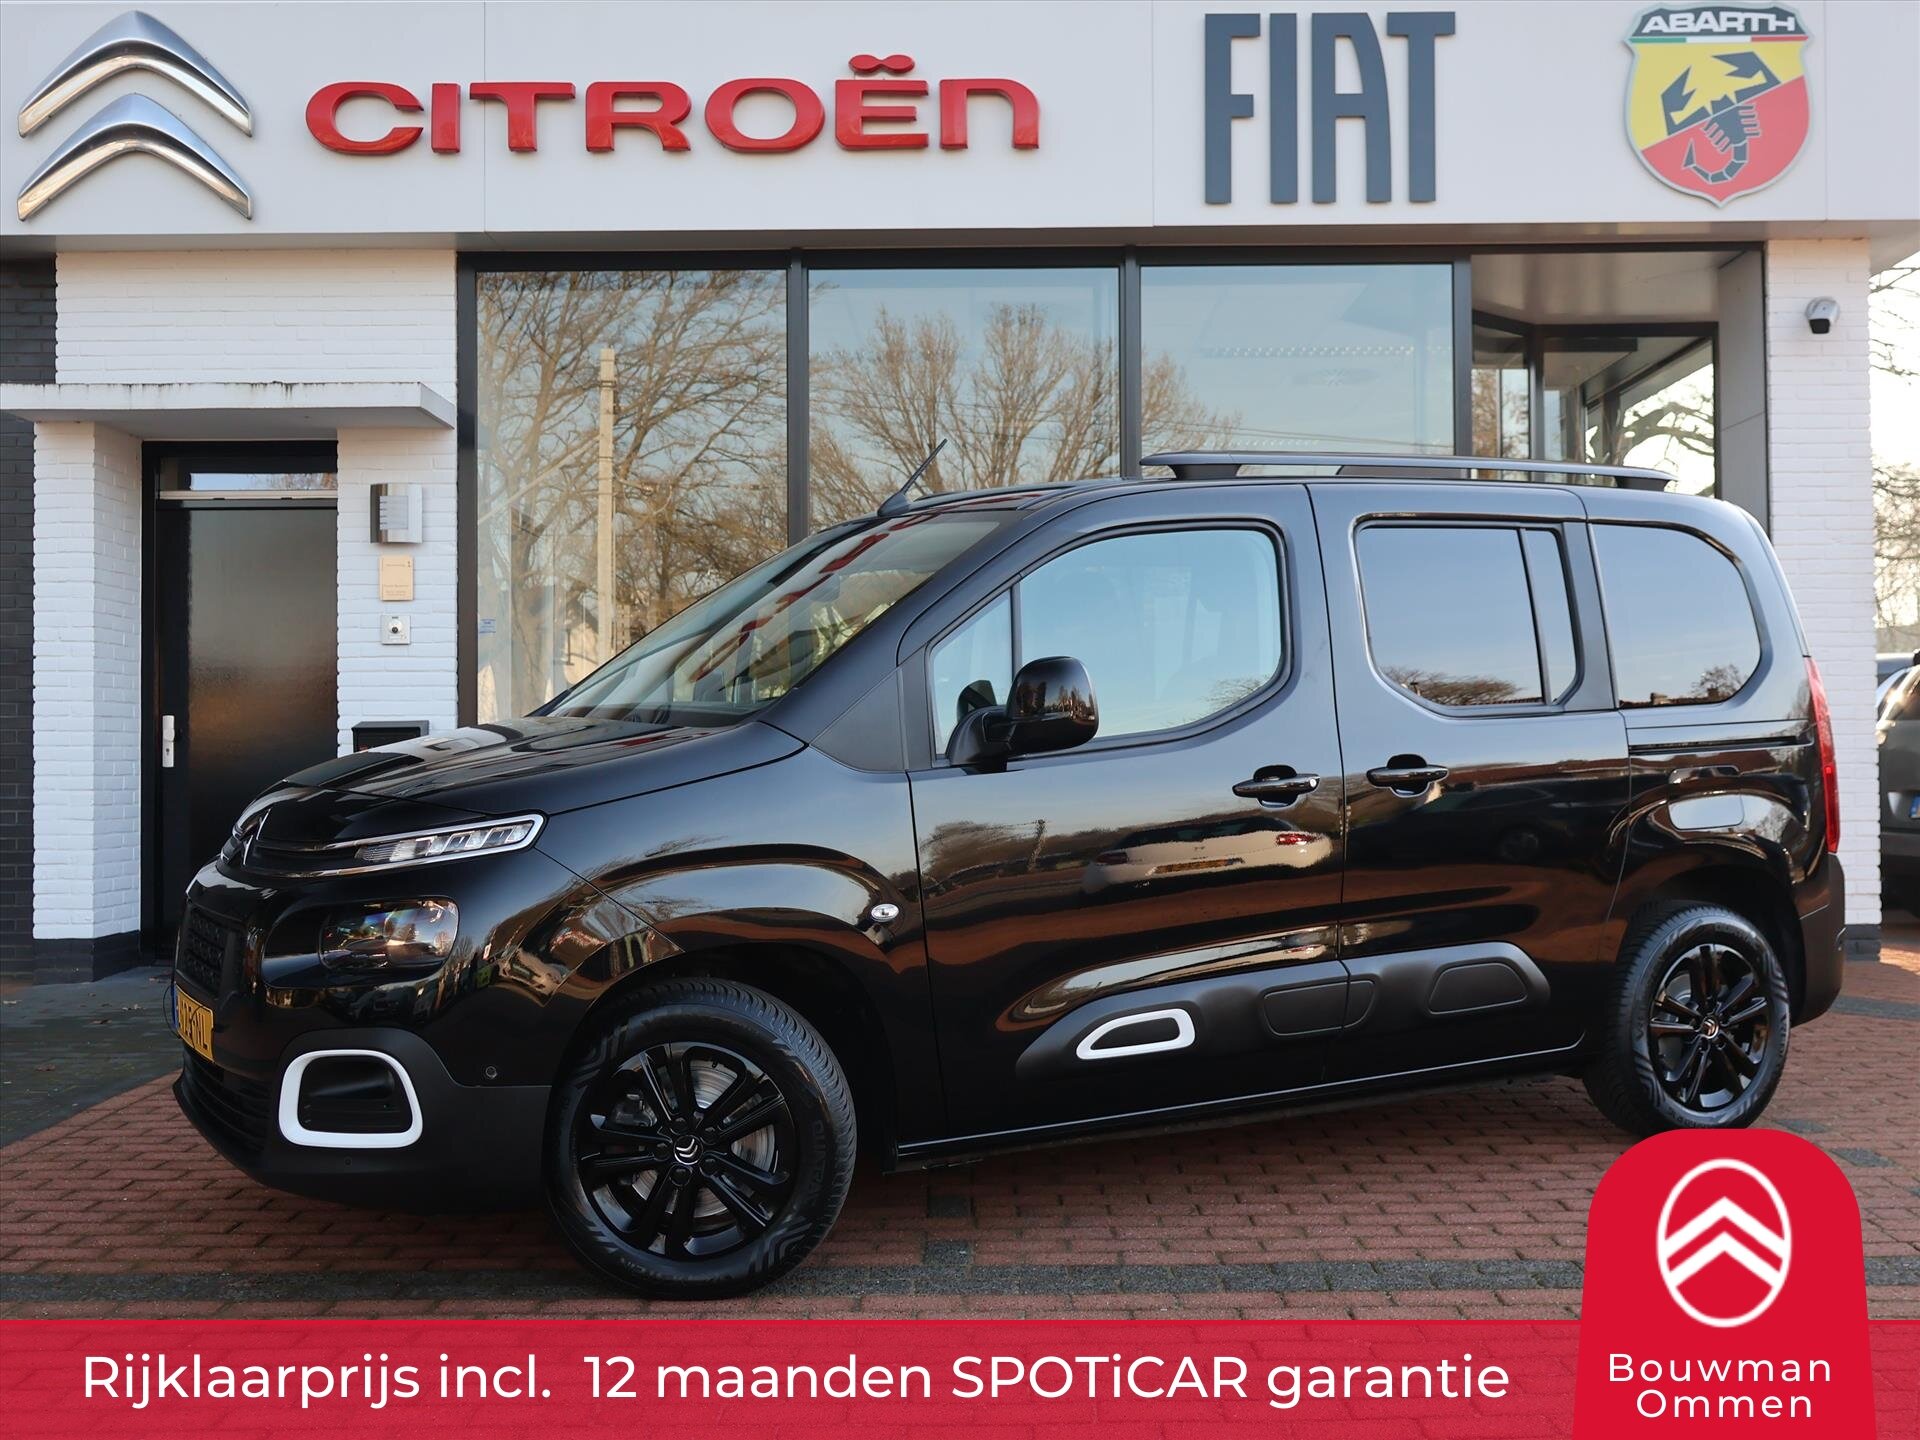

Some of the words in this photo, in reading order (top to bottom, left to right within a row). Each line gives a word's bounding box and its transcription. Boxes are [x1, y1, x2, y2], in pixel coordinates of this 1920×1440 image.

[1641, 10, 1796, 34] ABARTH
[306, 54, 1040, 154] CITROËN
[1204, 11, 1456, 205] FIAT
